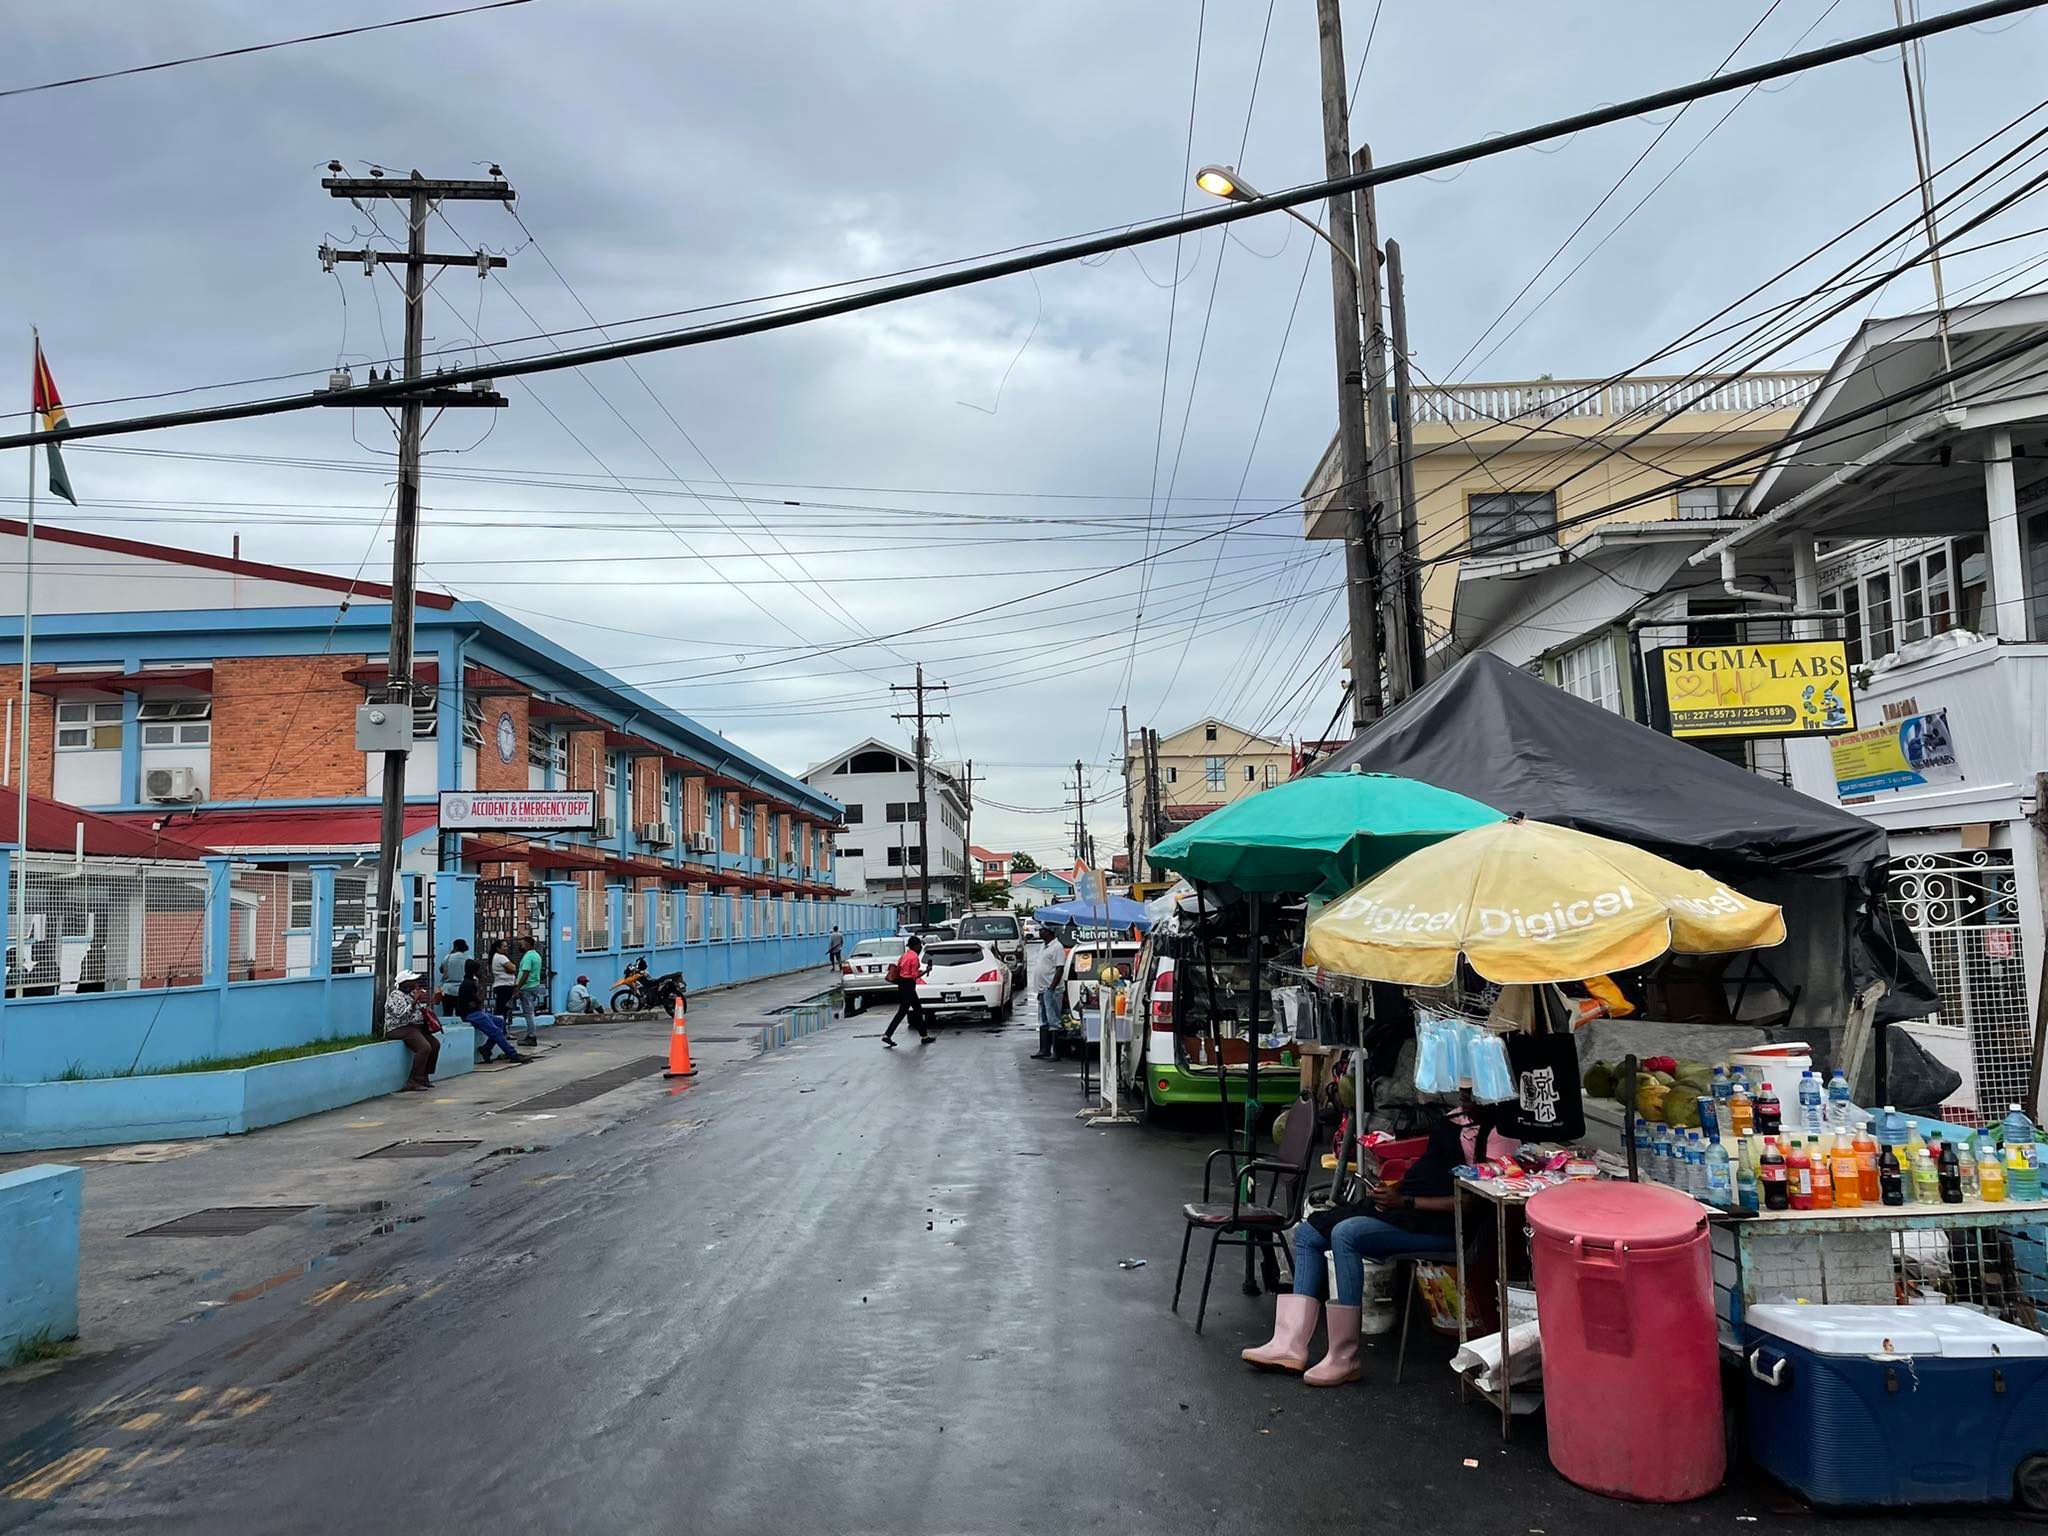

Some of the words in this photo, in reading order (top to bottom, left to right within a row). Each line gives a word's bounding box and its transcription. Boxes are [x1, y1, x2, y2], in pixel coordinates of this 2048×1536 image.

[1668, 648, 1768, 673] SIGMA
[1769, 655, 1845, 679] LABS
[1673, 712, 1691, 721] Tel:
[1693, 710, 1736, 720] 227-5573
[1743, 707, 1786, 718] 225-1899
[471, 801, 509, 816] ACCIDENT
[511, 802, 517, 816] &
[519, 801, 567, 816] EMERGENCY
[568, 801, 591, 816] DEPT.
[1336, 894, 1463, 933] Digicel
[1479, 884, 1635, 941] Digicel
